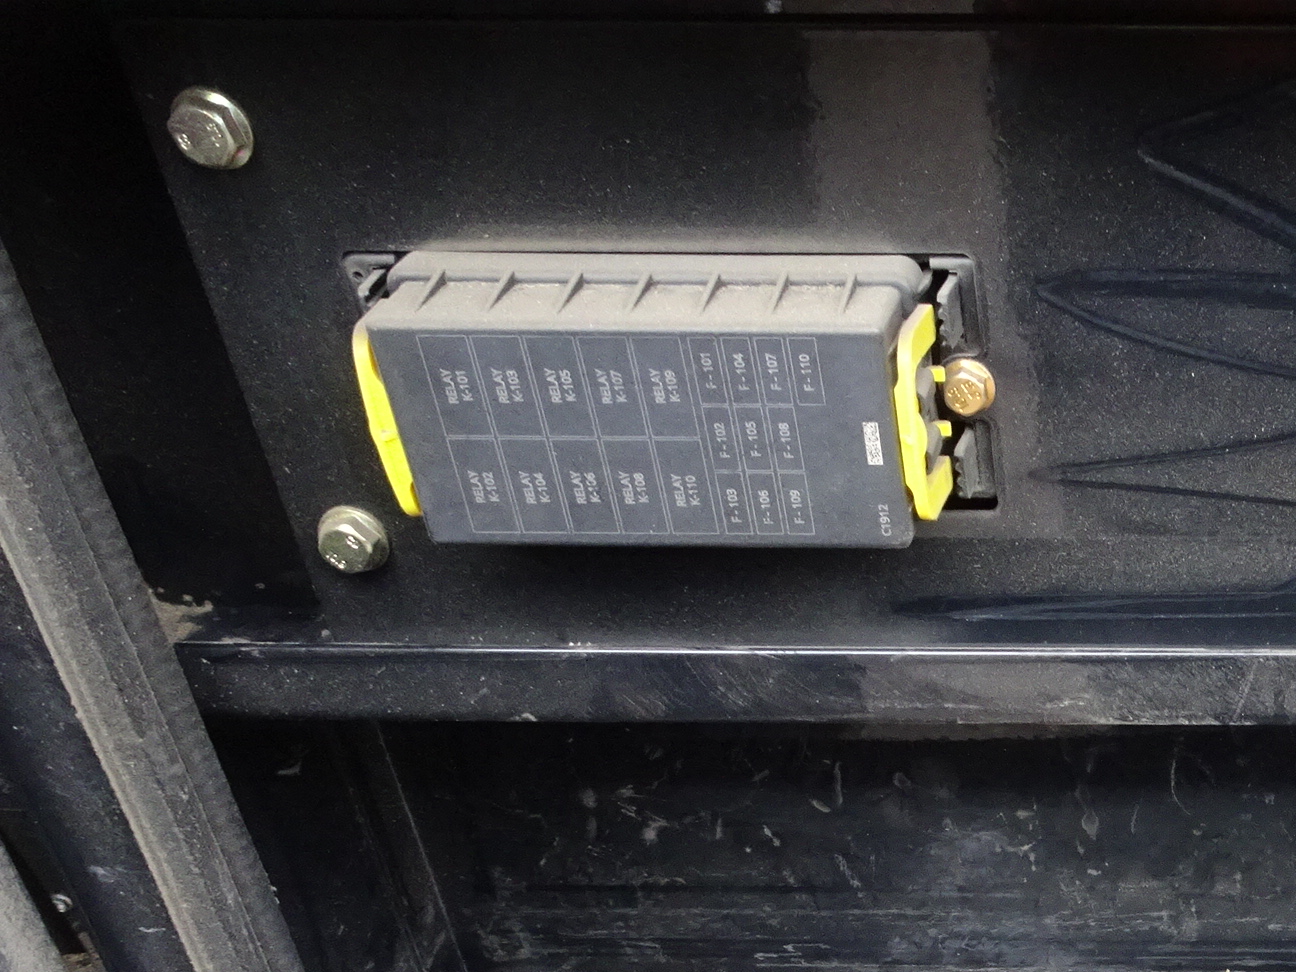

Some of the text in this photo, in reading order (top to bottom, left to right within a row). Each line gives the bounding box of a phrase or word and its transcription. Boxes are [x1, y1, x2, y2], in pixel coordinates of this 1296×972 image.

[440, 368, 459, 404] RELAY
[455, 370, 473, 401] K-101
[490, 368, 510, 404] RELAY
[506, 369, 524, 402] K-103
[543, 368, 563, 403] RELAY
[559, 369, 577, 401] K-105
[594, 368, 613, 404] RELAY
[610, 370, 628, 403] K-107
[649, 368, 667, 404] RELAY
[664, 369, 680, 402] K-109
[467, 470, 486, 503] RELAY
[482, 471, 500, 502] K-102
[518, 471, 537, 504] RELAY
[533, 472, 551, 503] K-104
[569, 471, 587, 504] RELAY
[618, 471, 637, 505] RELAY
[634, 472, 649, 503] K-108
[670, 474, 687, 507] RELAY
[685, 475, 701, 506] K-110
[878, 504, 892, 537] C1912
